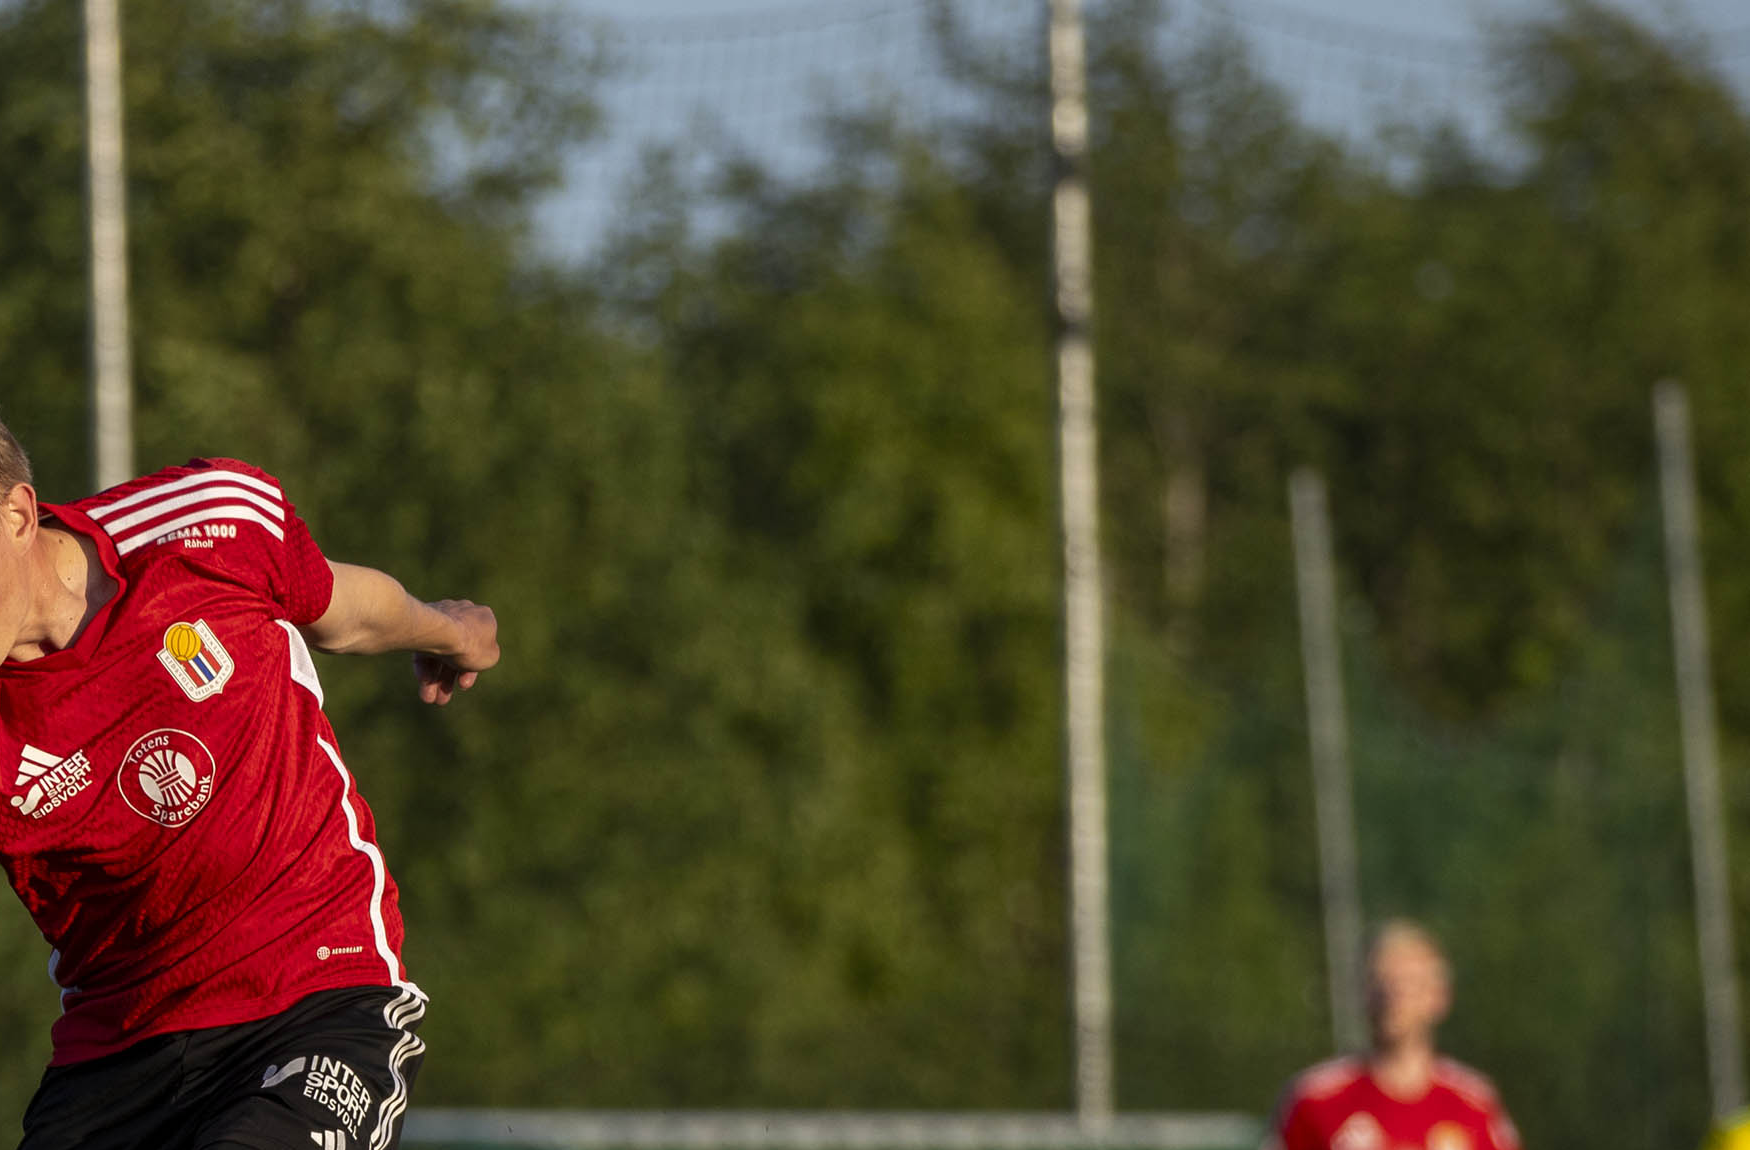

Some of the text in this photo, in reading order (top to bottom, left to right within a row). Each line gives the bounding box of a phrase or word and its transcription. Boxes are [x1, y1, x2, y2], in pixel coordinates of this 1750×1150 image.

[203, 523, 237, 538] 1000
[127, 735, 170, 764] Totens
[39, 751, 88, 792] INTER
[47, 761, 91, 798] SPORT
[32, 777, 93, 820] EIDSVOLL
[151, 775, 211, 822] Sparebank
[306, 1071, 366, 1126] SPORT
[311, 1055, 371, 1112] INTER
[303, 1086, 357, 1140] EIDSVOLL
